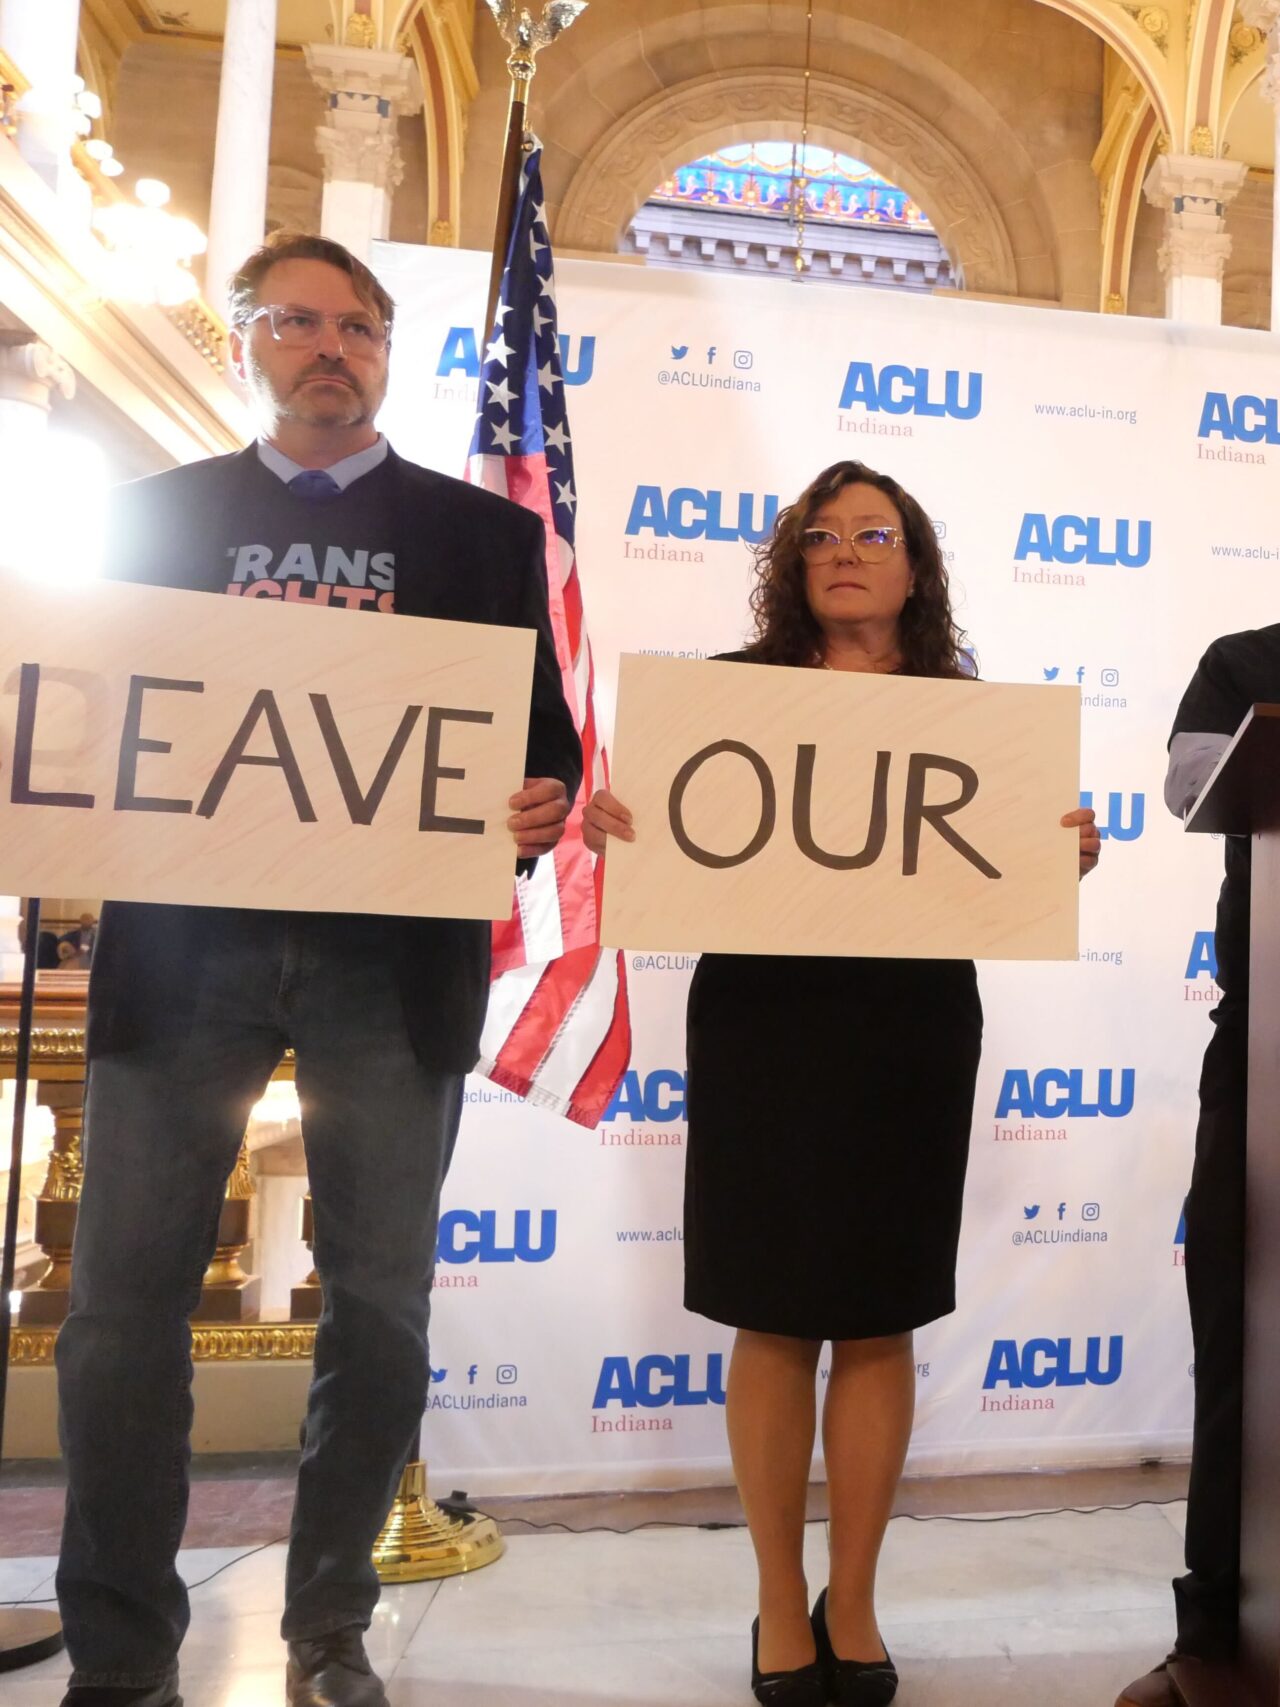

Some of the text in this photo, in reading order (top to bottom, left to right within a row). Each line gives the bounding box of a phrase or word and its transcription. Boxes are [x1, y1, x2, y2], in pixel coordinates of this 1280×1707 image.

[657, 370, 762, 392] @ACLUindiana
[838, 361, 983, 420] ACLU
[1034, 402, 1137, 425] www.aclu-in.org
[837, 415, 914, 437] Indiana
[1197, 443, 1266, 465] Indiana
[624, 485, 779, 545] ACLU
[1013, 513, 1152, 568] ACLU
[623, 541, 705, 564] Indiana
[1012, 566, 1086, 587] Indiana
[10, 662, 494, 835] LEAVE
[668, 739, 1002, 880] OUR
[994, 1068, 1136, 1119] ACLU
[600, 1129, 683, 1146] Indiana
[994, 1123, 1068, 1142] Indiana
[434, 1209, 557, 1265] CLU
[1011, 1228, 1108, 1246] @ACLUindiana
[981, 1335, 1124, 1390] ACLU
[980, 1395, 1056, 1412] Indiana
[591, 1414, 674, 1434] Indiana
